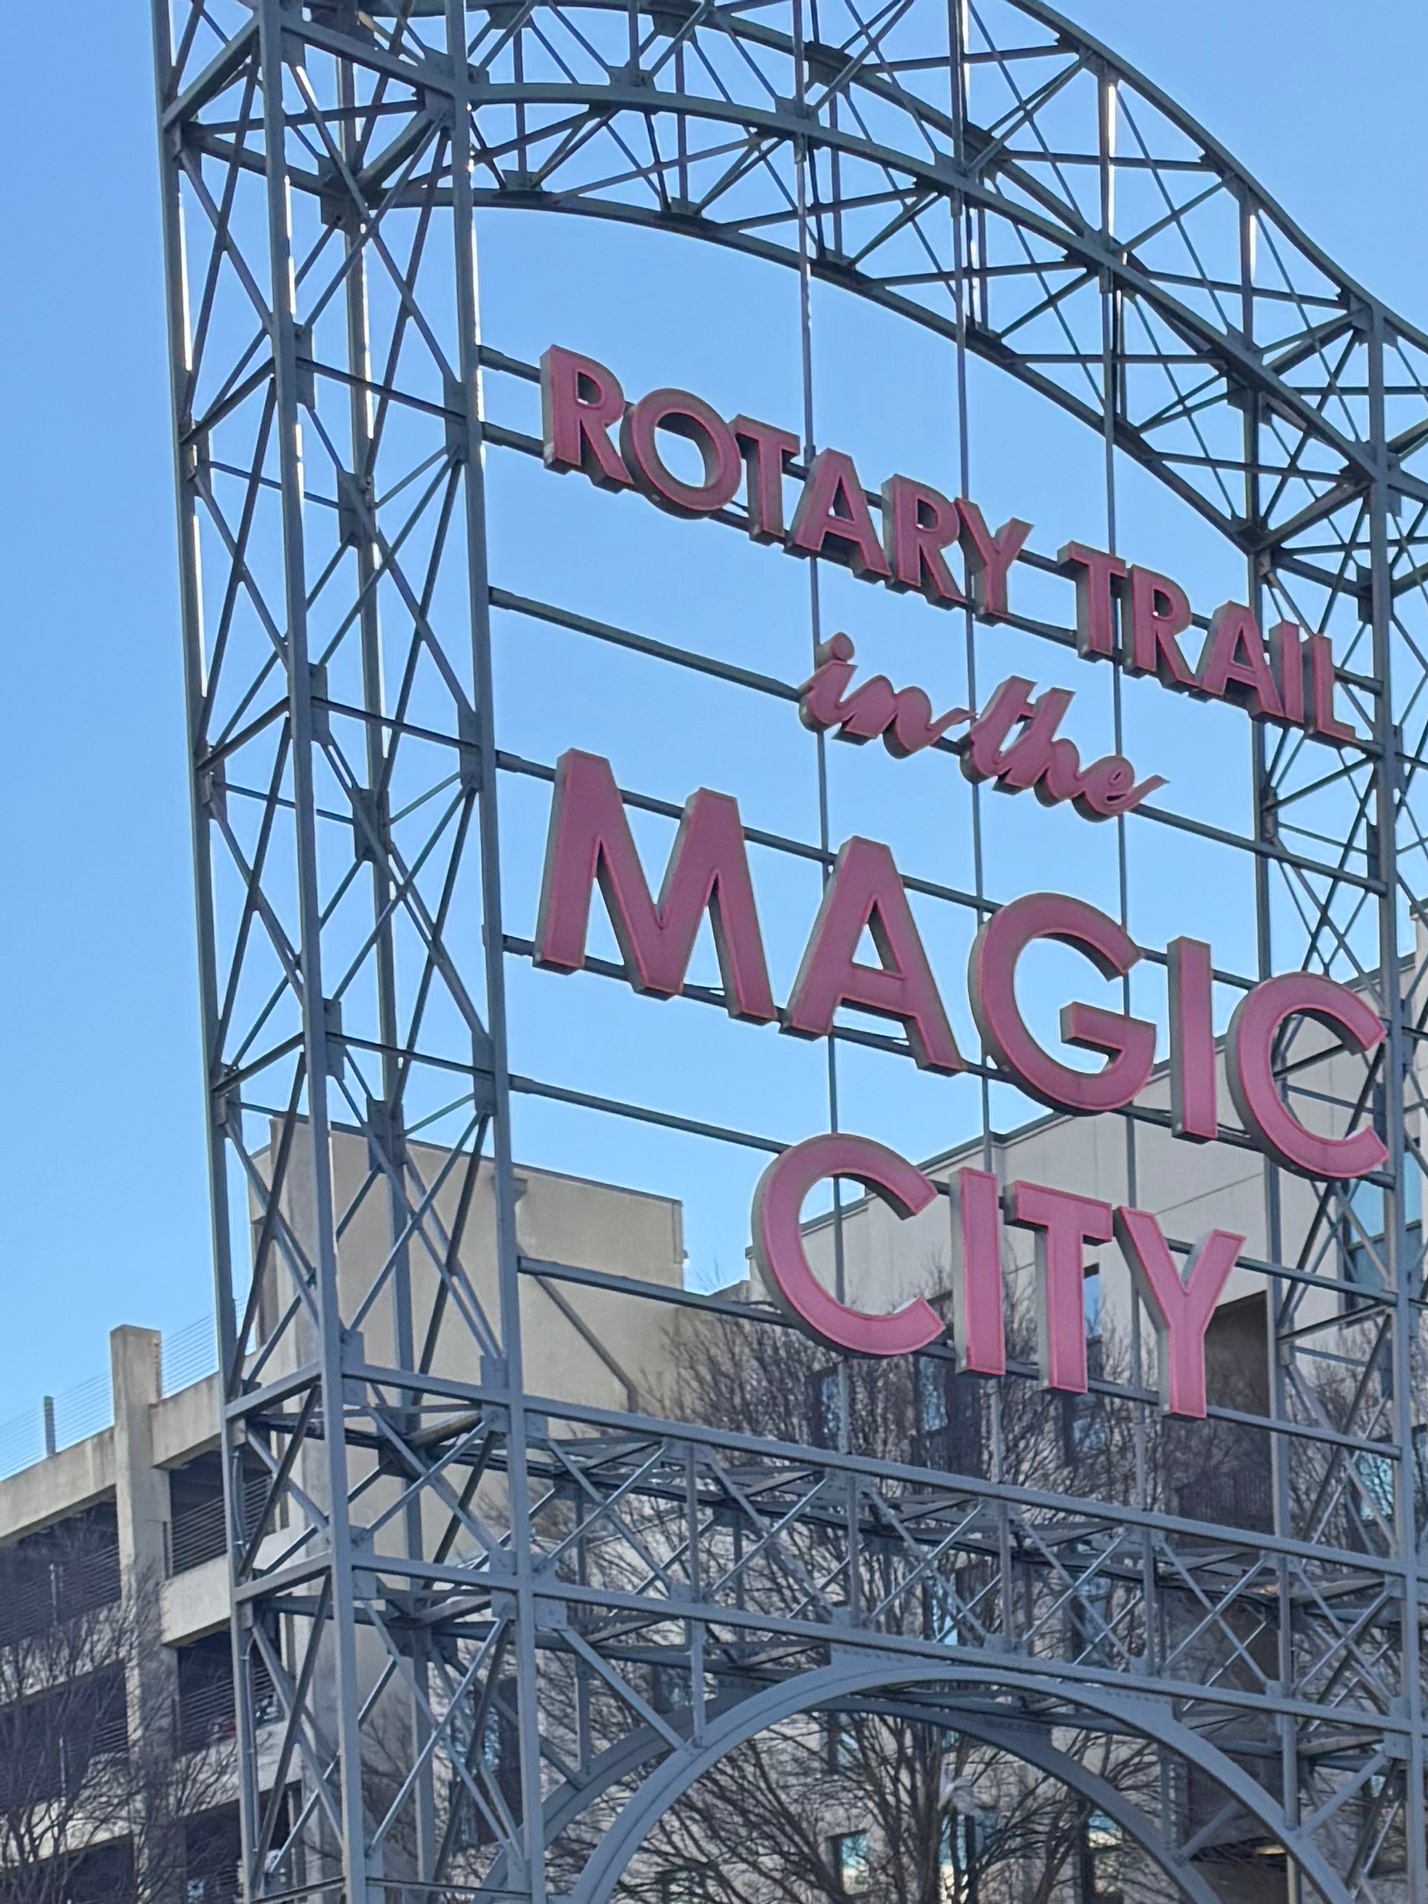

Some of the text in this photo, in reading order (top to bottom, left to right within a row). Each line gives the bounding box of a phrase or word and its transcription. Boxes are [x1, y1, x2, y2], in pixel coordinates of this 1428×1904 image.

[539, 344, 1357, 747] ROTARY TRAIL
[799, 631, 1170, 823] in the
[532, 747, 1390, 1181] MAGIC
[751, 1131, 1246, 1421] CITY
